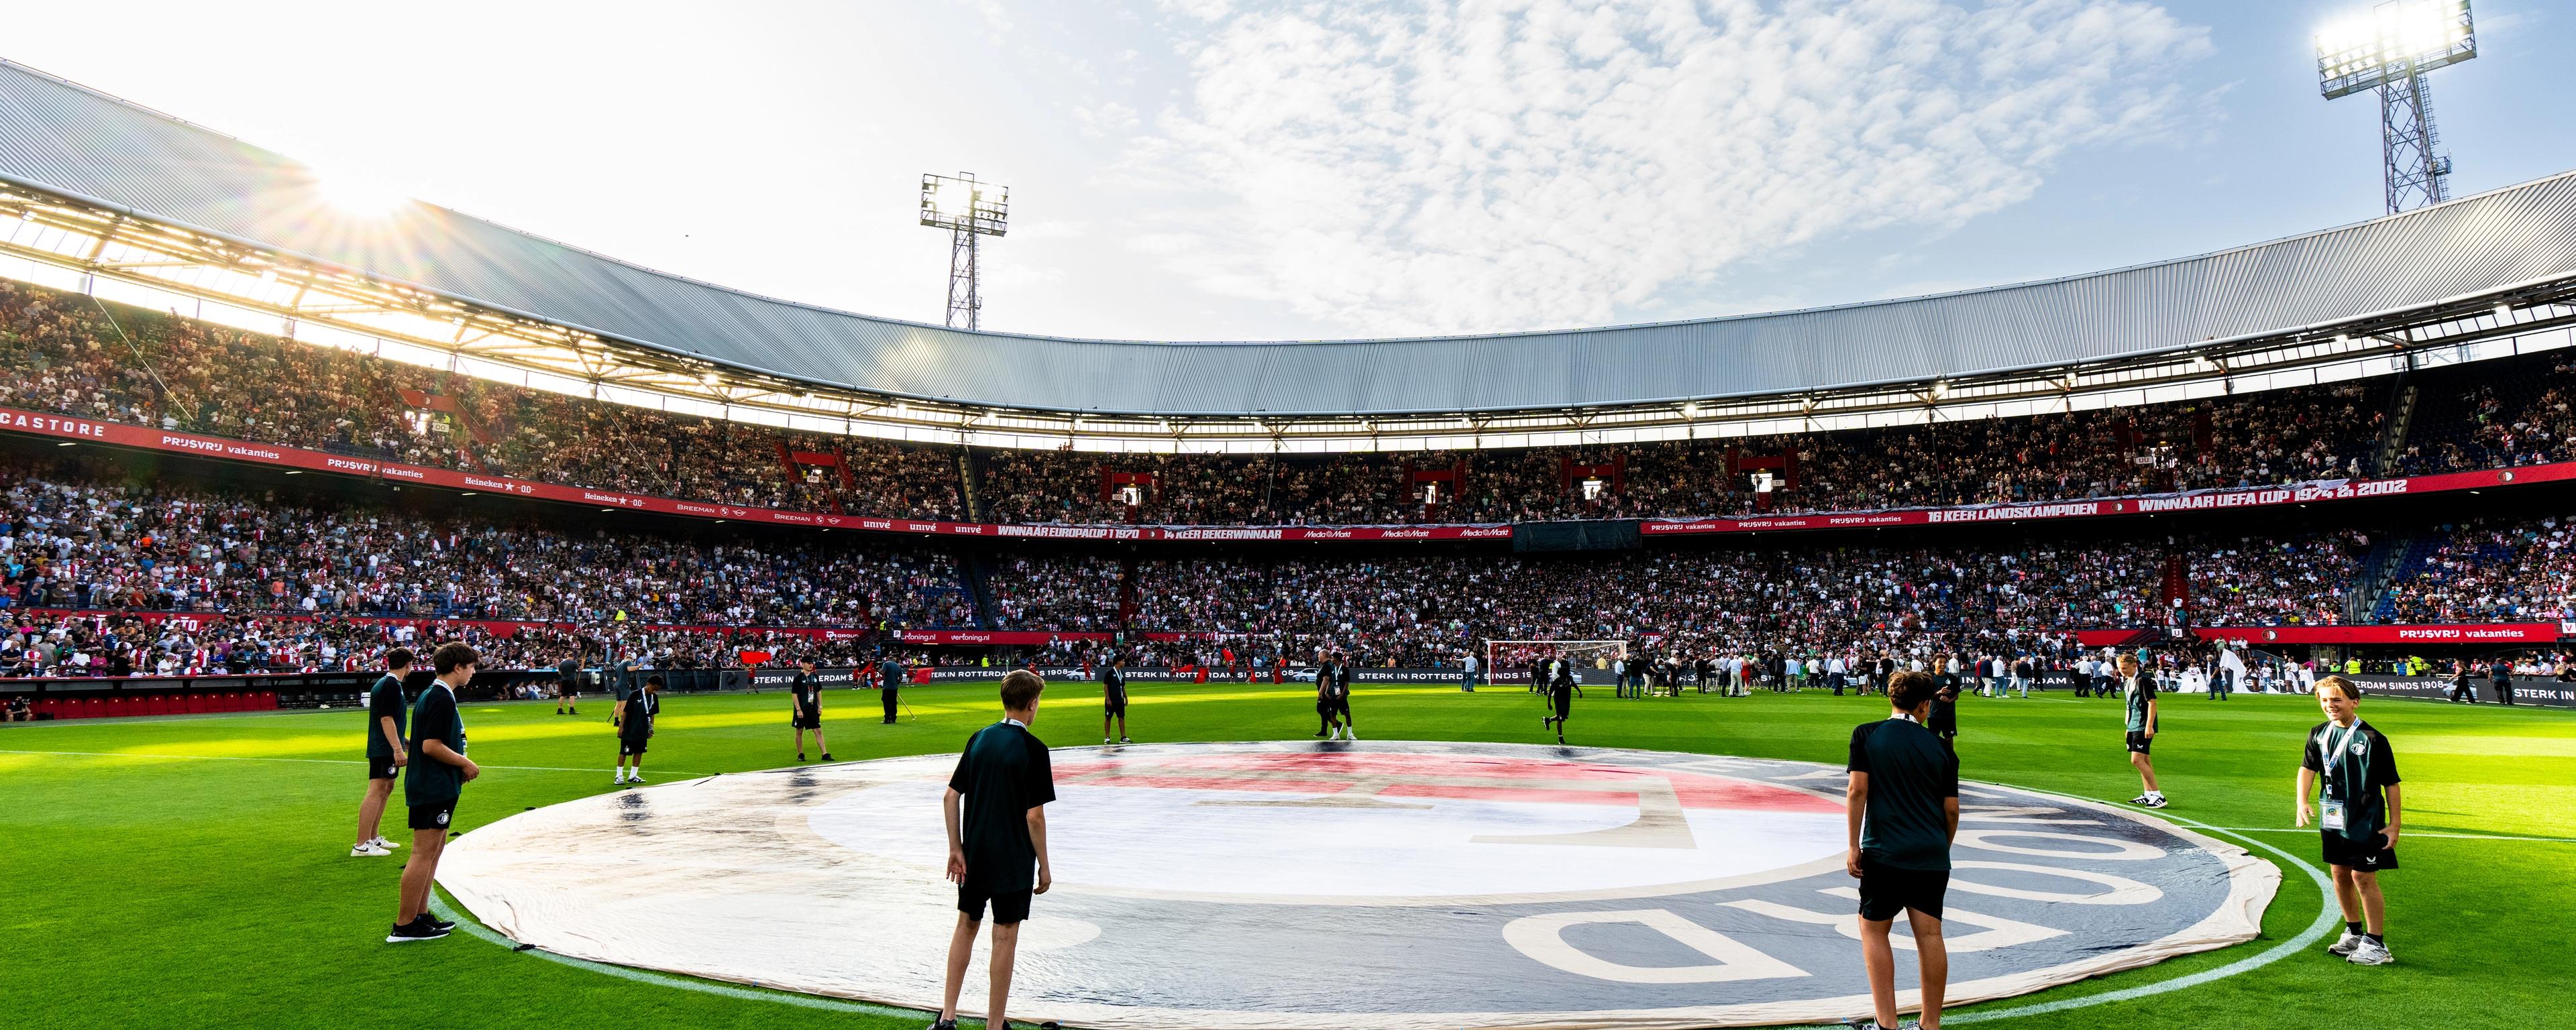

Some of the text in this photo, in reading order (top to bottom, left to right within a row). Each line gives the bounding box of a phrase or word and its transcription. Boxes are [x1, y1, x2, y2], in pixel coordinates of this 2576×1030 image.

[0, 412, 105, 437] CASTORE
[162, 436, 280, 459] PRIJSVRIJ vakanties
[382, 467, 424, 478] vakanties
[465, 477, 503, 489] Heineken
[584, 492, 617, 504] Heineken
[2138, 496, 2216, 512] WINNAAR
[2217, 492, 2257, 507] UEFA
[2259, 490, 2290, 504] CUP
[2294, 487, 2334, 502] 1974
[2357, 479, 2408, 496] 2002
[677, 504, 715, 514] BREEMAN
[1927, 504, 2098, 522] 16 KEER LANDSKAMPIOEN
[774, 514, 811, 522] BREEMAN
[998, 525, 1049, 537] WINNAAR
[1049, 527, 1108, 538] EUROPACUP
[1115, 528, 1140, 538] 1970
[1175, 530, 1201, 539] KEER
[1201, 530, 1282, 539] BEKERWINNAAR
[951, 633, 990, 642] verloning.nl
[2400, 628, 2524, 638] PRIJSVRIJ vakanties
[754, 676, 784, 684] STERK
[785, 675, 794, 683] IN
[2389, 682, 2420, 690] SINDS
[2420, 680, 2445, 690] 1908
[2514, 688, 2574, 700] STERK IN
